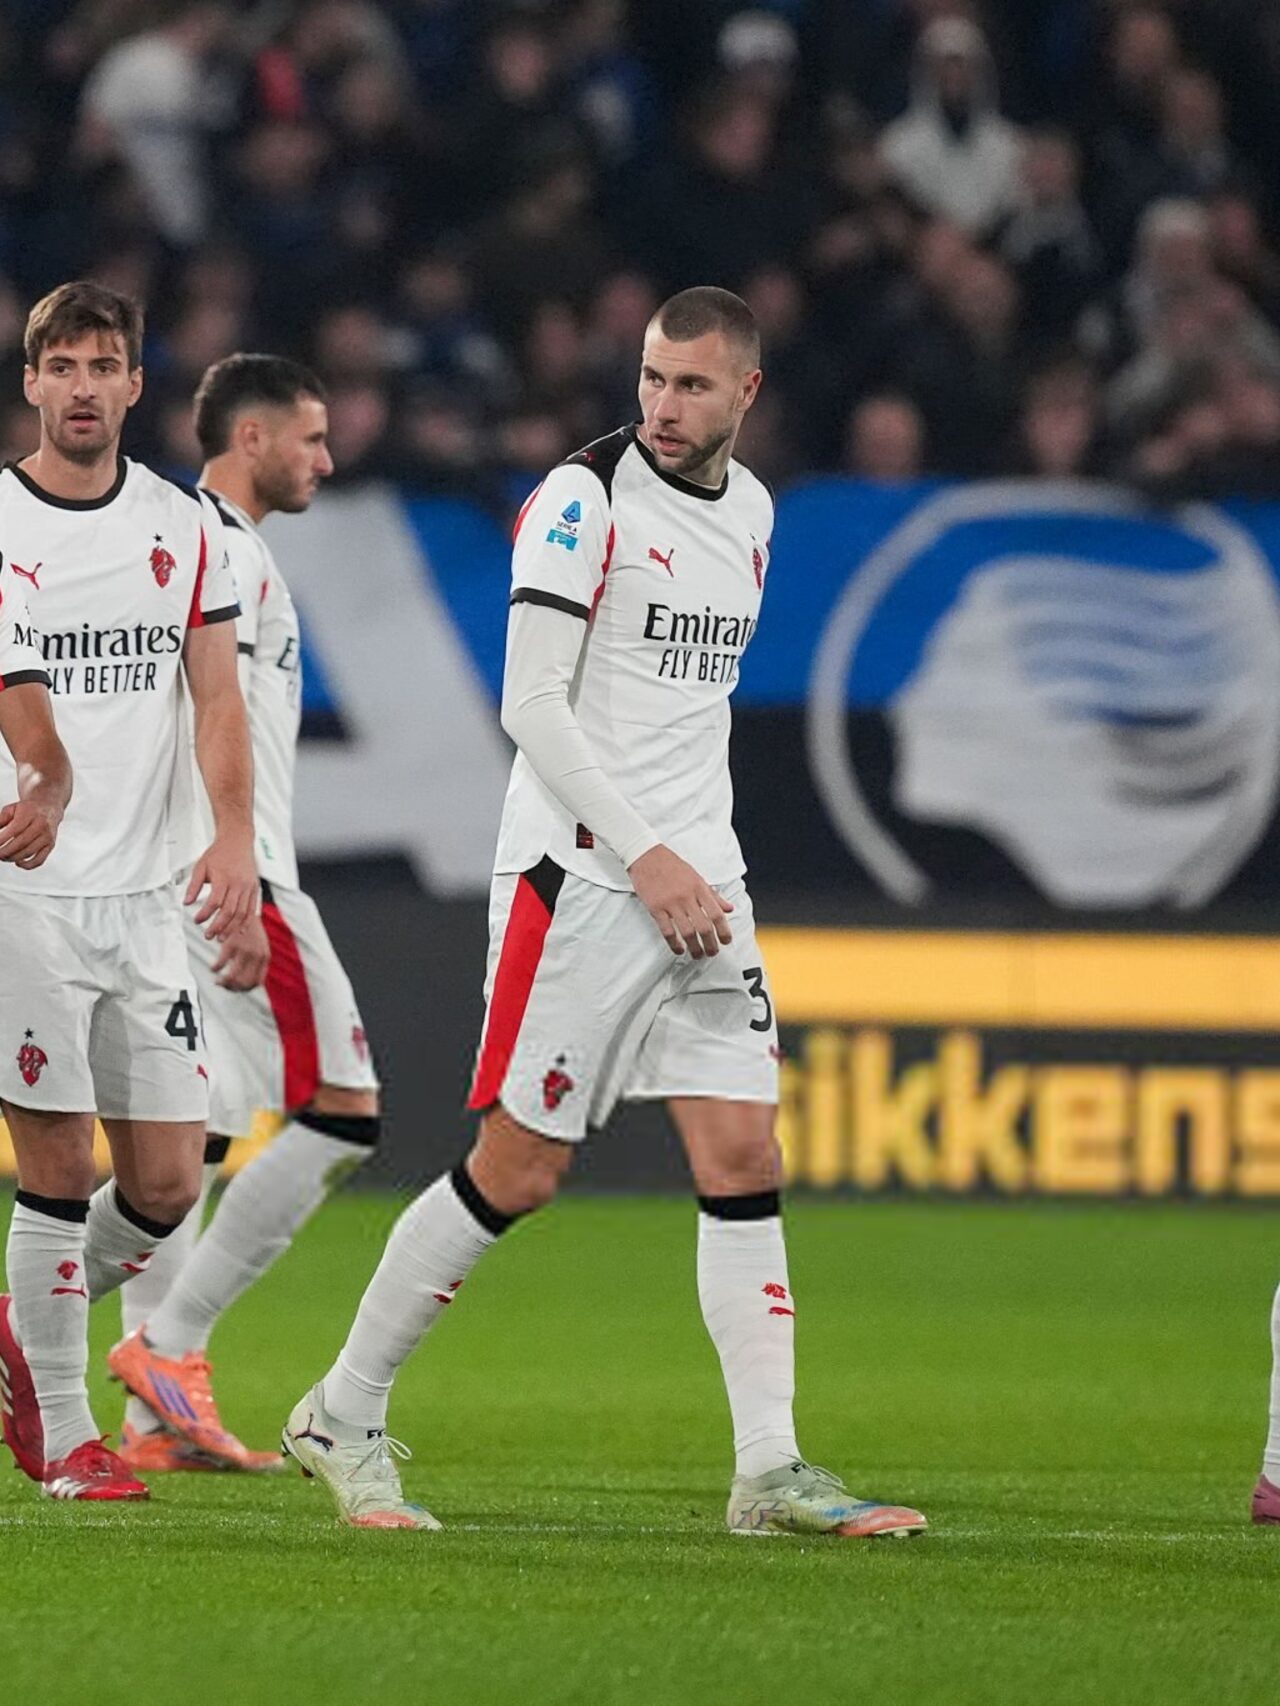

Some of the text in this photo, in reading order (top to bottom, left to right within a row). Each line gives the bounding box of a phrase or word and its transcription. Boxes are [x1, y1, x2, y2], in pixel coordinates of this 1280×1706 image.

[33, 621, 182, 661] mirates
[46, 662, 157, 695] LY BETTER
[658, 648, 741, 684] FLY BETT
[742, 966, 772, 1033] 3
[164, 989, 198, 1051] 4
